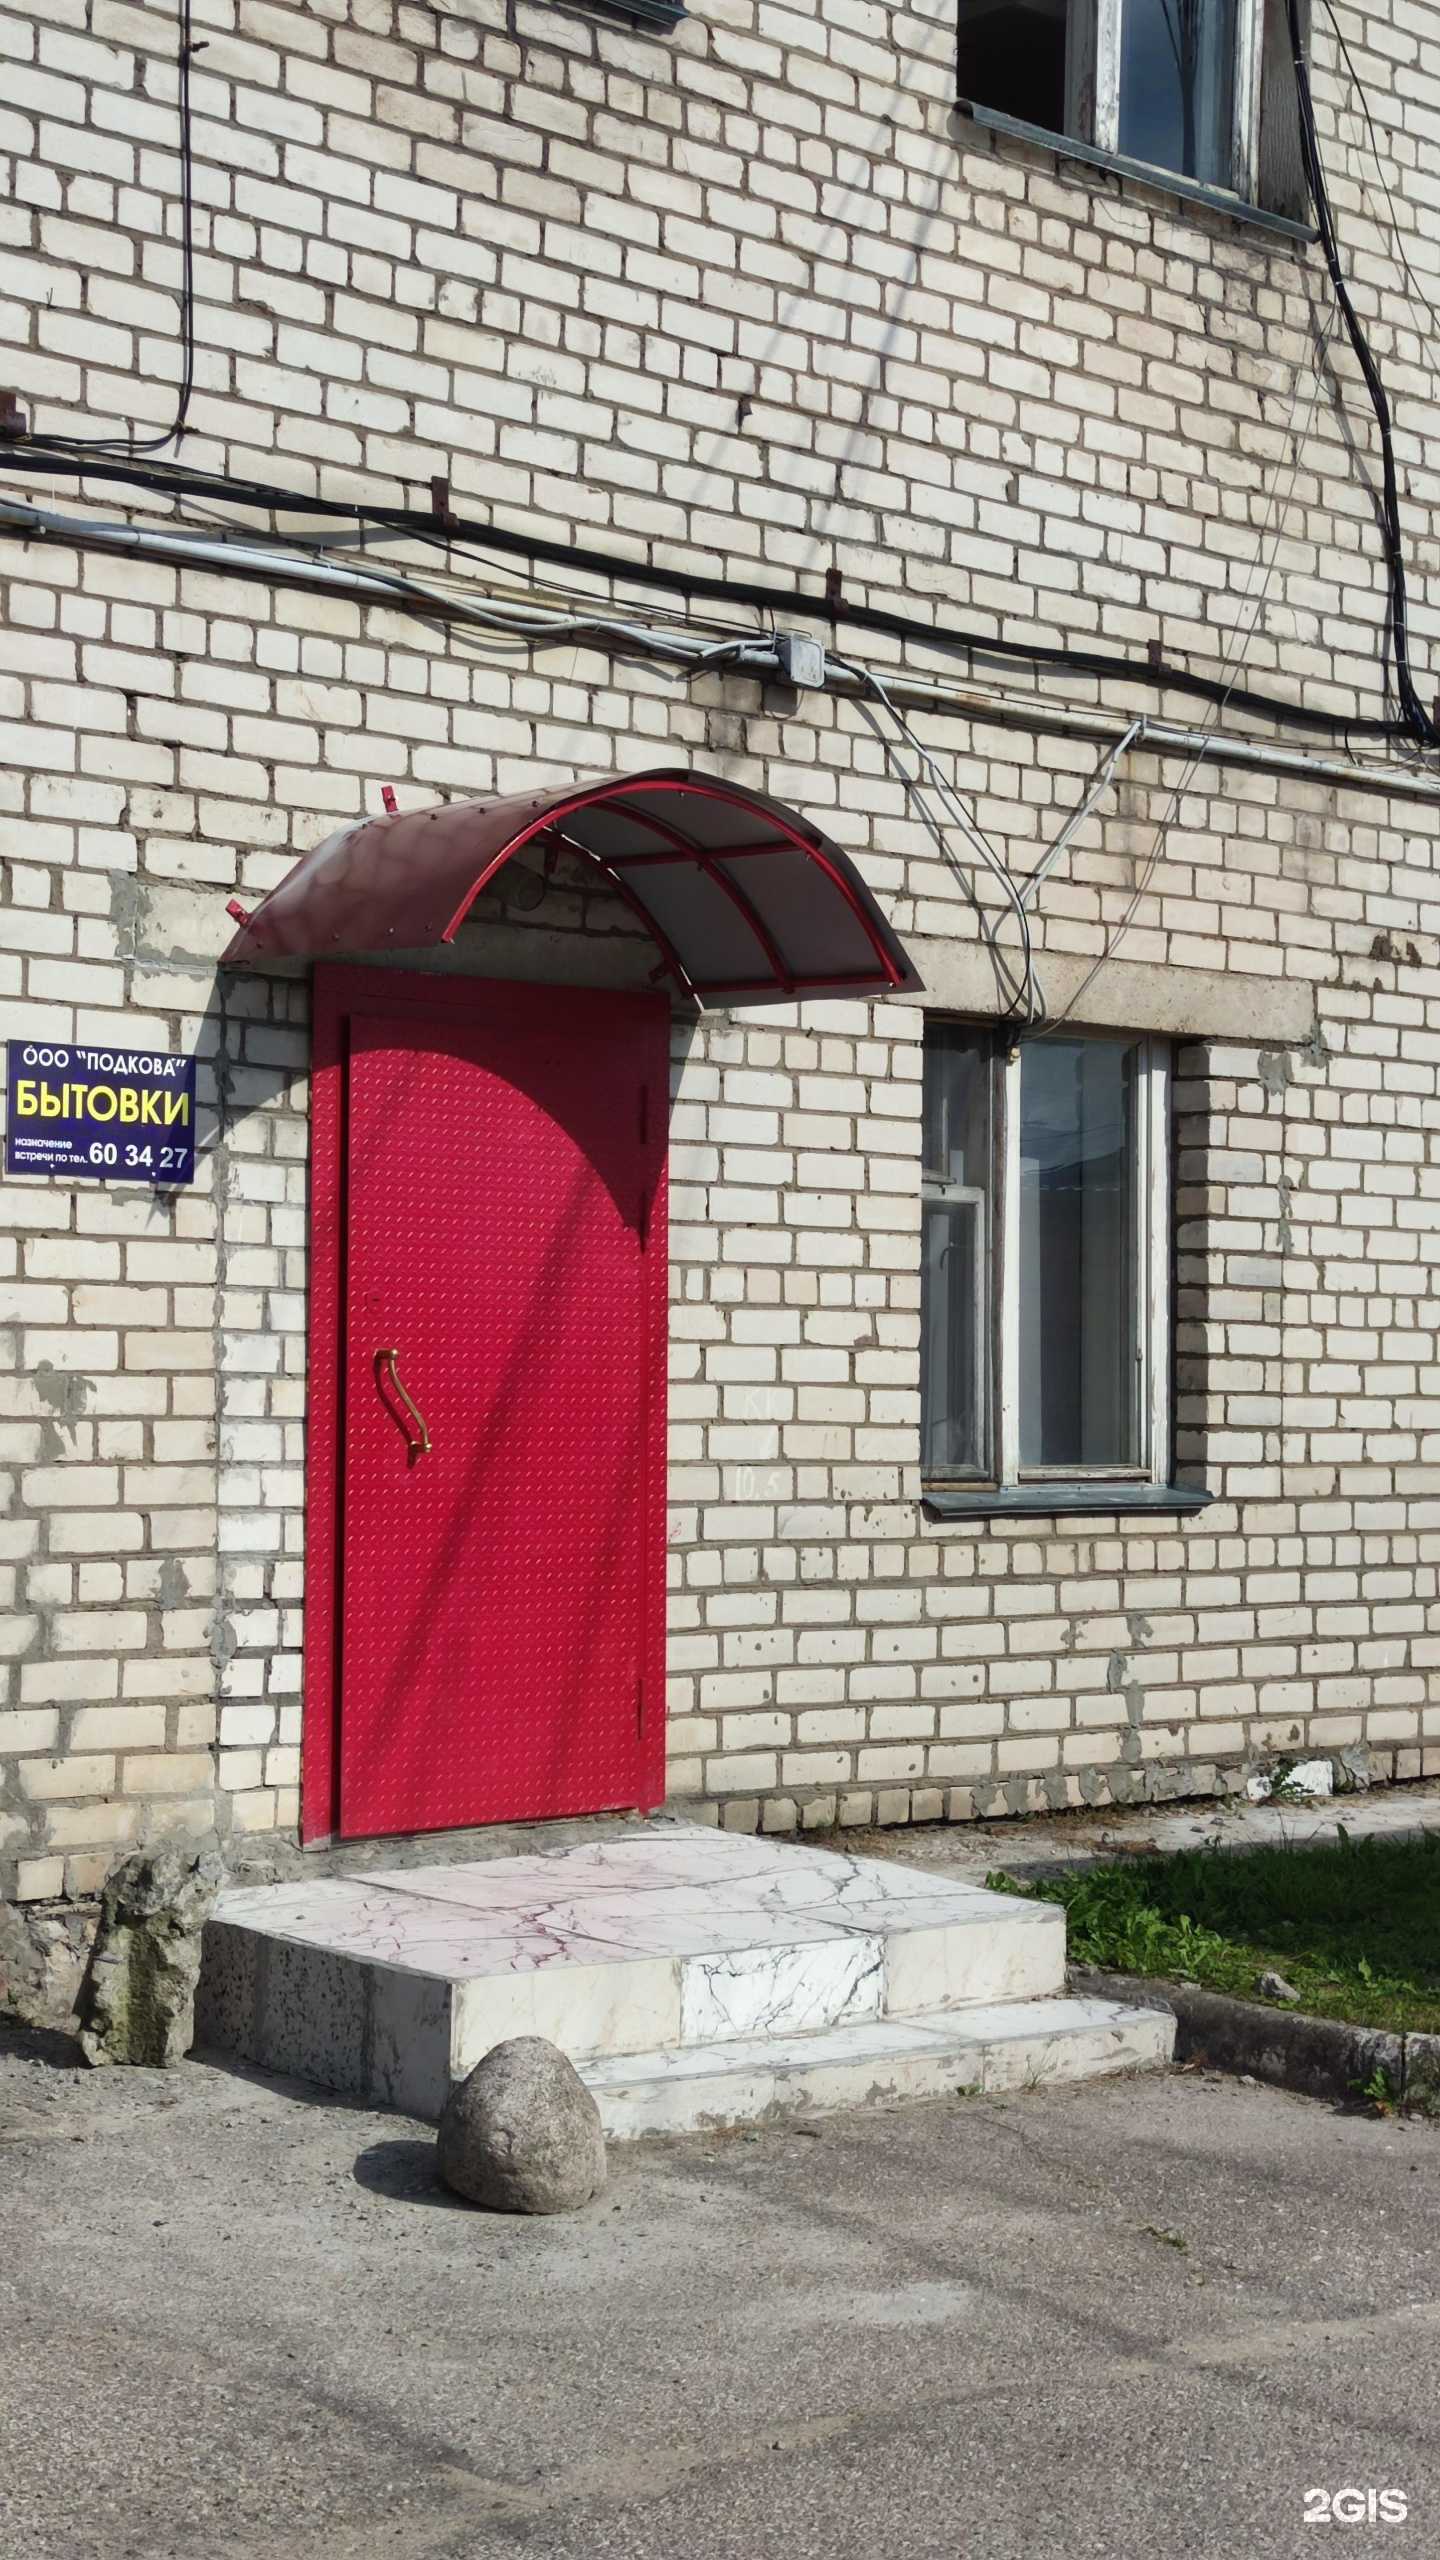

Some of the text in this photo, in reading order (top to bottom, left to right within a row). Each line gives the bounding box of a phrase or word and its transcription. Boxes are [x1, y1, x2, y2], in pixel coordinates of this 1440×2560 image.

[23, 1047, 187, 1077] ООО "ПОДКОВА"
[16, 1079, 189, 1127] БЫТОВКИ
[14, 1142, 188, 1169] встречи по тел. 60 34 27
[15, 1137, 72, 1150] назначение
